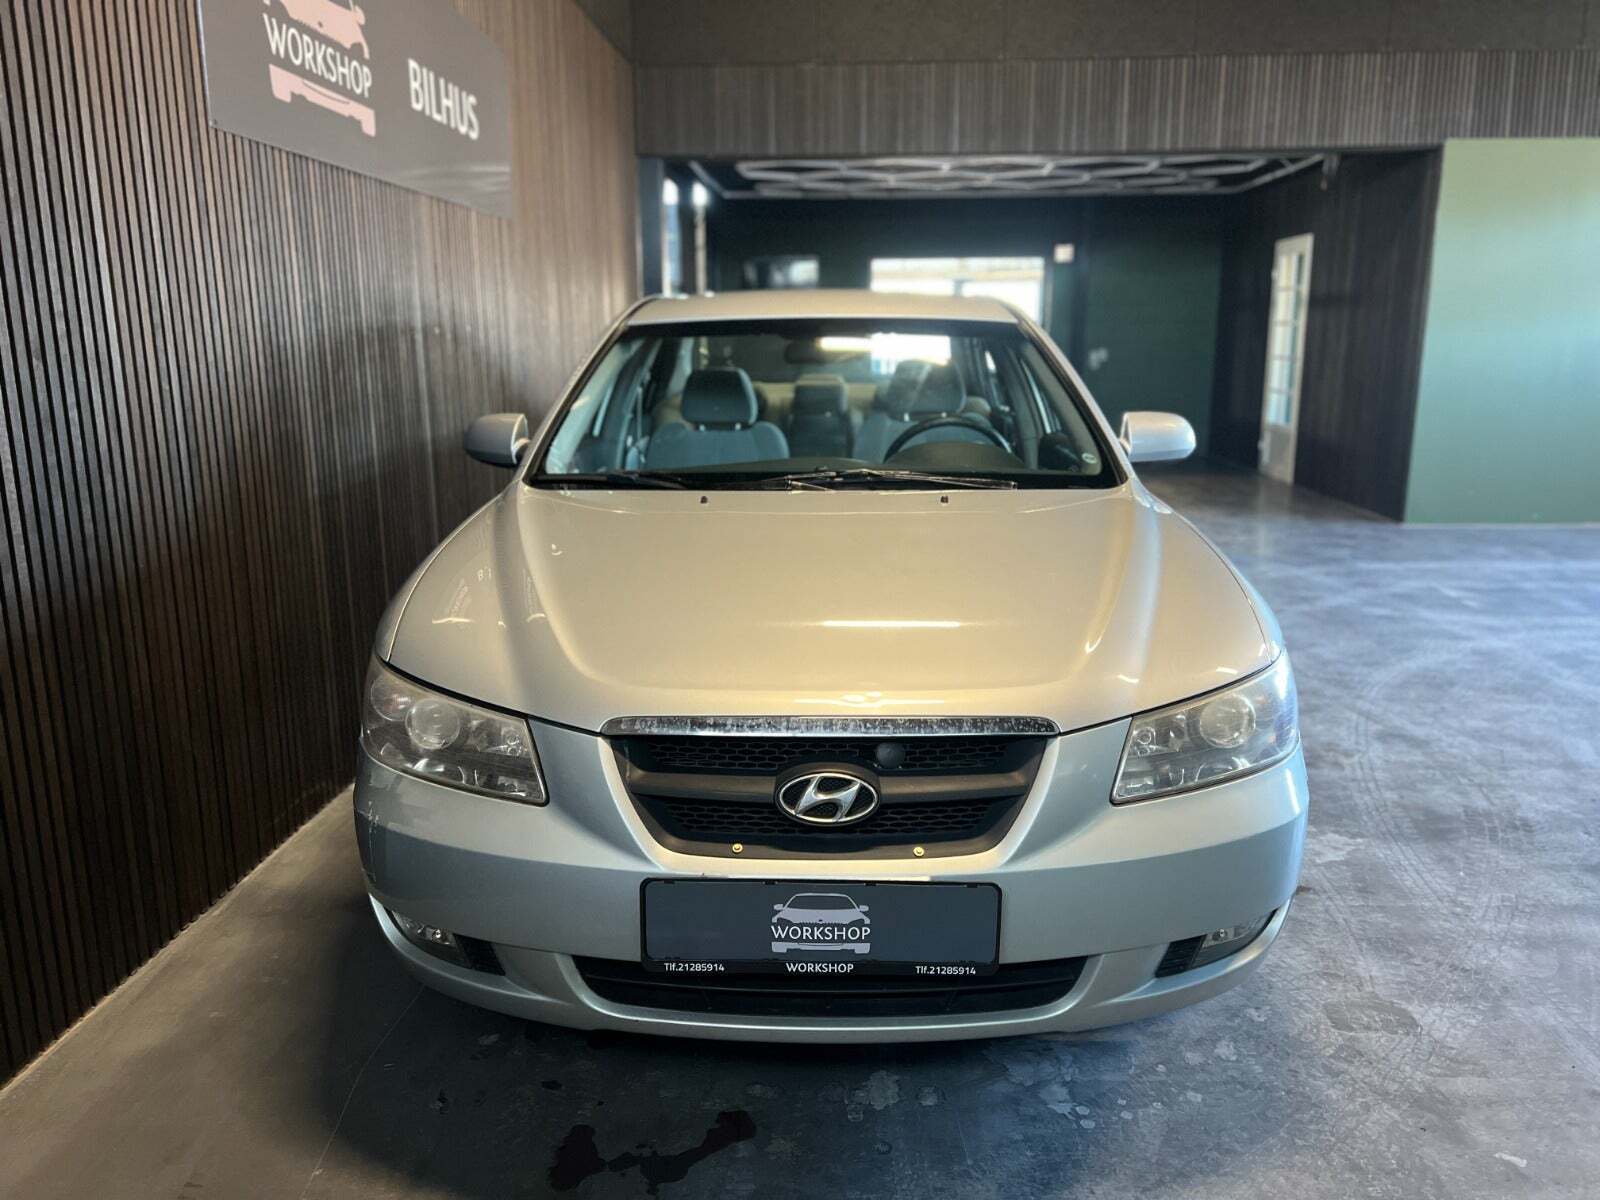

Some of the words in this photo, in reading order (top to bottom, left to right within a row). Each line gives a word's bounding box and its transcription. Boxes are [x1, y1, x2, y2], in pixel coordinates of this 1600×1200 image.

[263, 14, 372, 98] WORKSHOP
[408, 57, 479, 140] BILHUS
[771, 925, 871, 940] WORKSHOP
[786, 962, 854, 974] WORKSHOP
